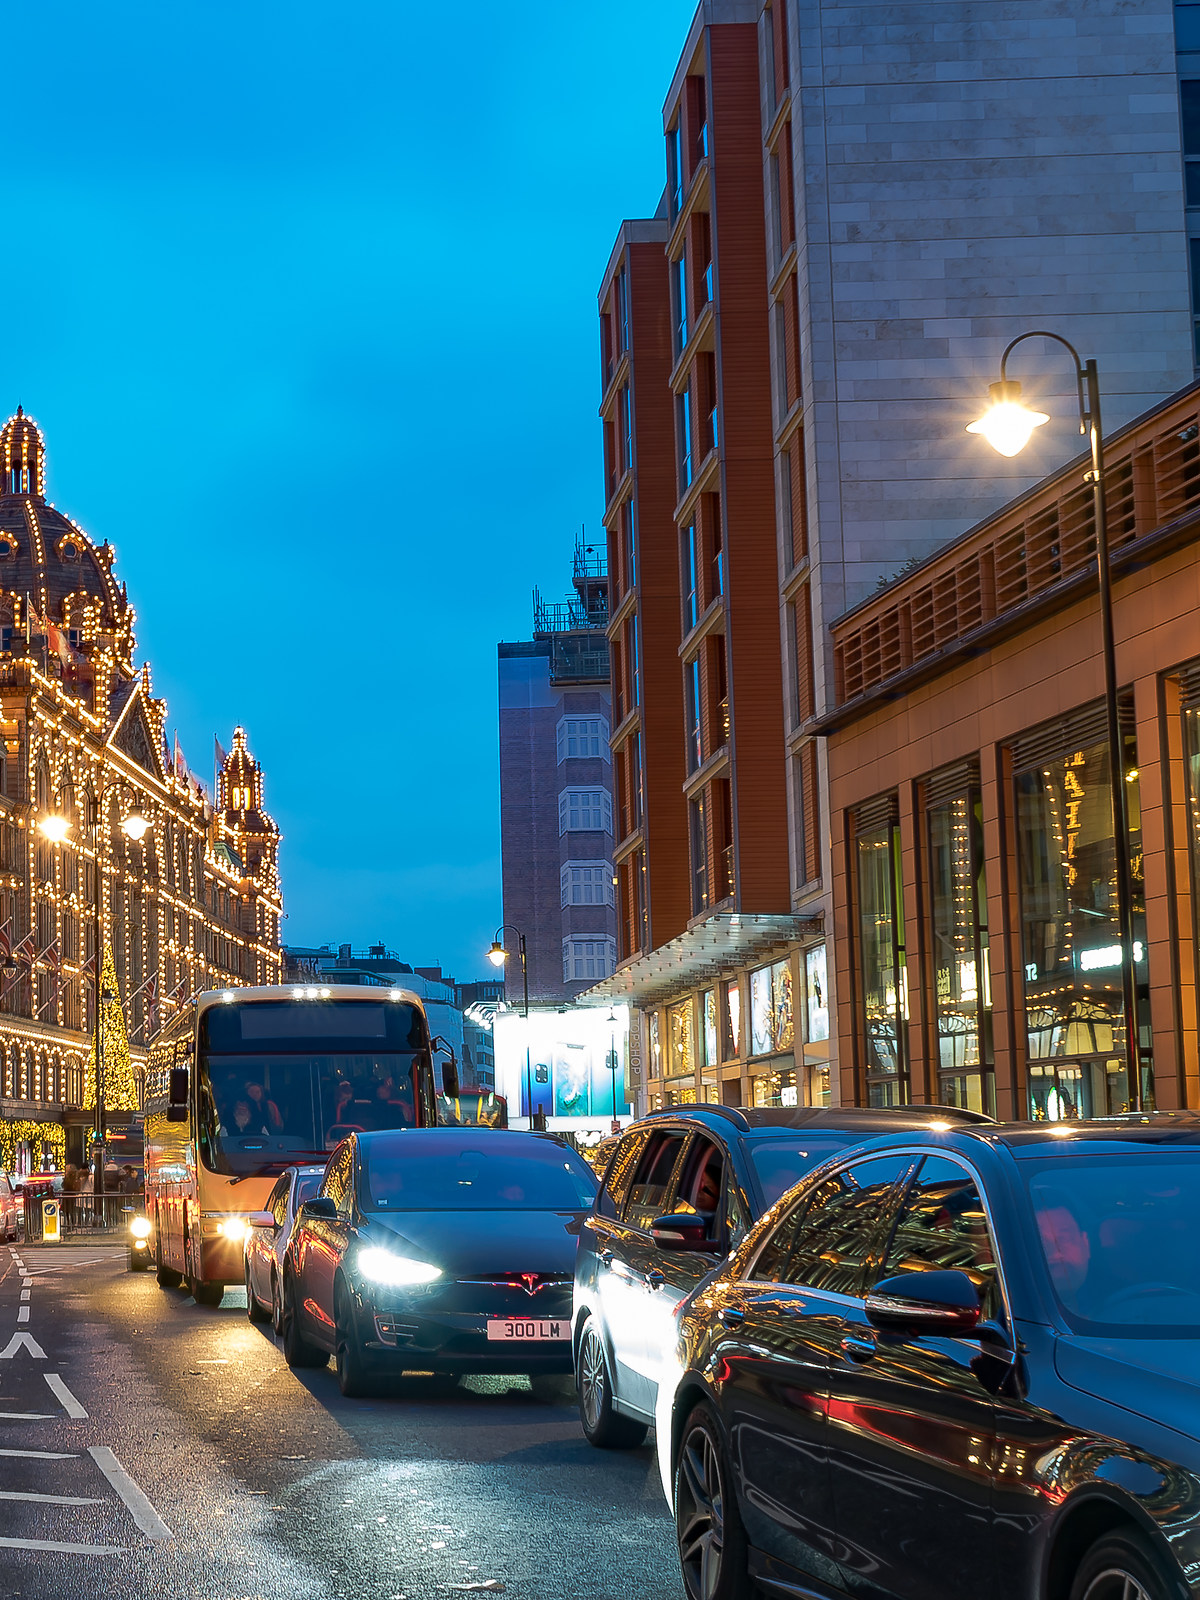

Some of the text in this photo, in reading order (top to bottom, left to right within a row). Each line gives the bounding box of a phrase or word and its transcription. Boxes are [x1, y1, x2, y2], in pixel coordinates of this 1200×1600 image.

[631, 1016, 641, 1075] TOPSHOP
[504, 1322, 560, 1338] 300 LM
